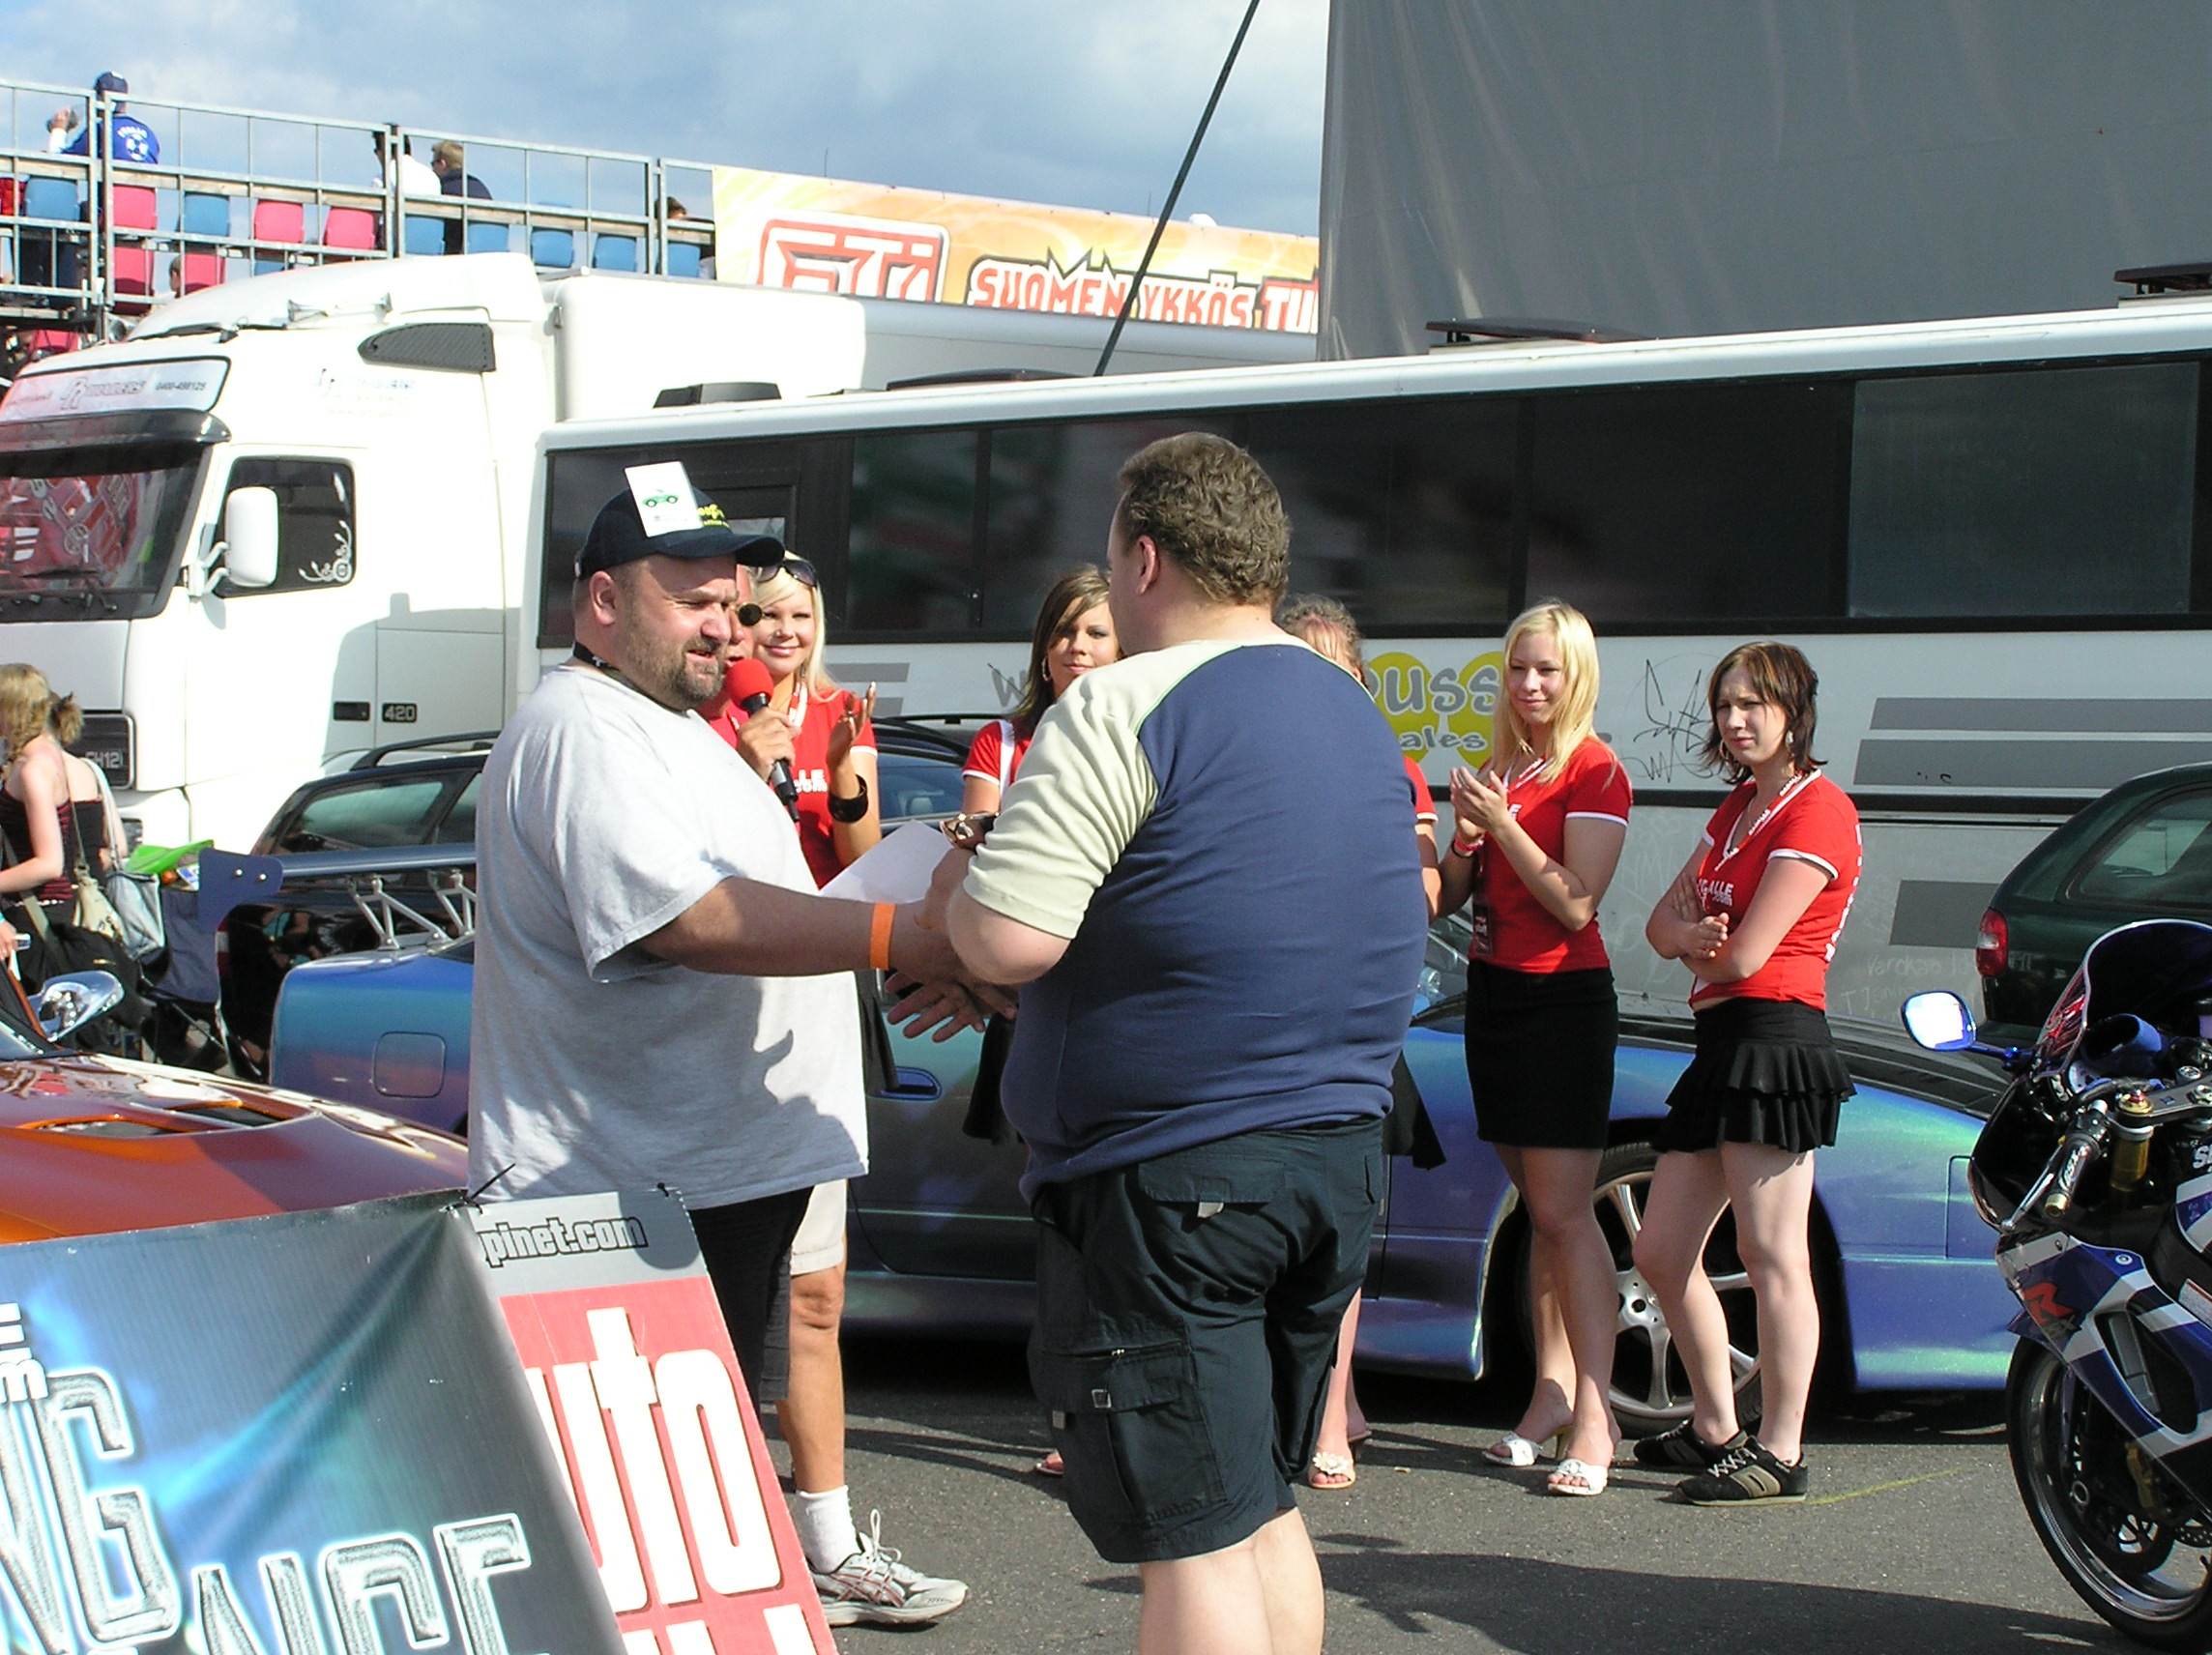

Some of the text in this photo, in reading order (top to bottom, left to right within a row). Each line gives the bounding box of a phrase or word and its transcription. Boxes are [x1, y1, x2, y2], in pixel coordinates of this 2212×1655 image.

[969, 257, 1318, 334] SUOMEN YKKÖS TU
[385, 705, 416, 721] 420
[476, 1217, 649, 1268] pinet.com
[524, 1307, 782, 1612] uto
